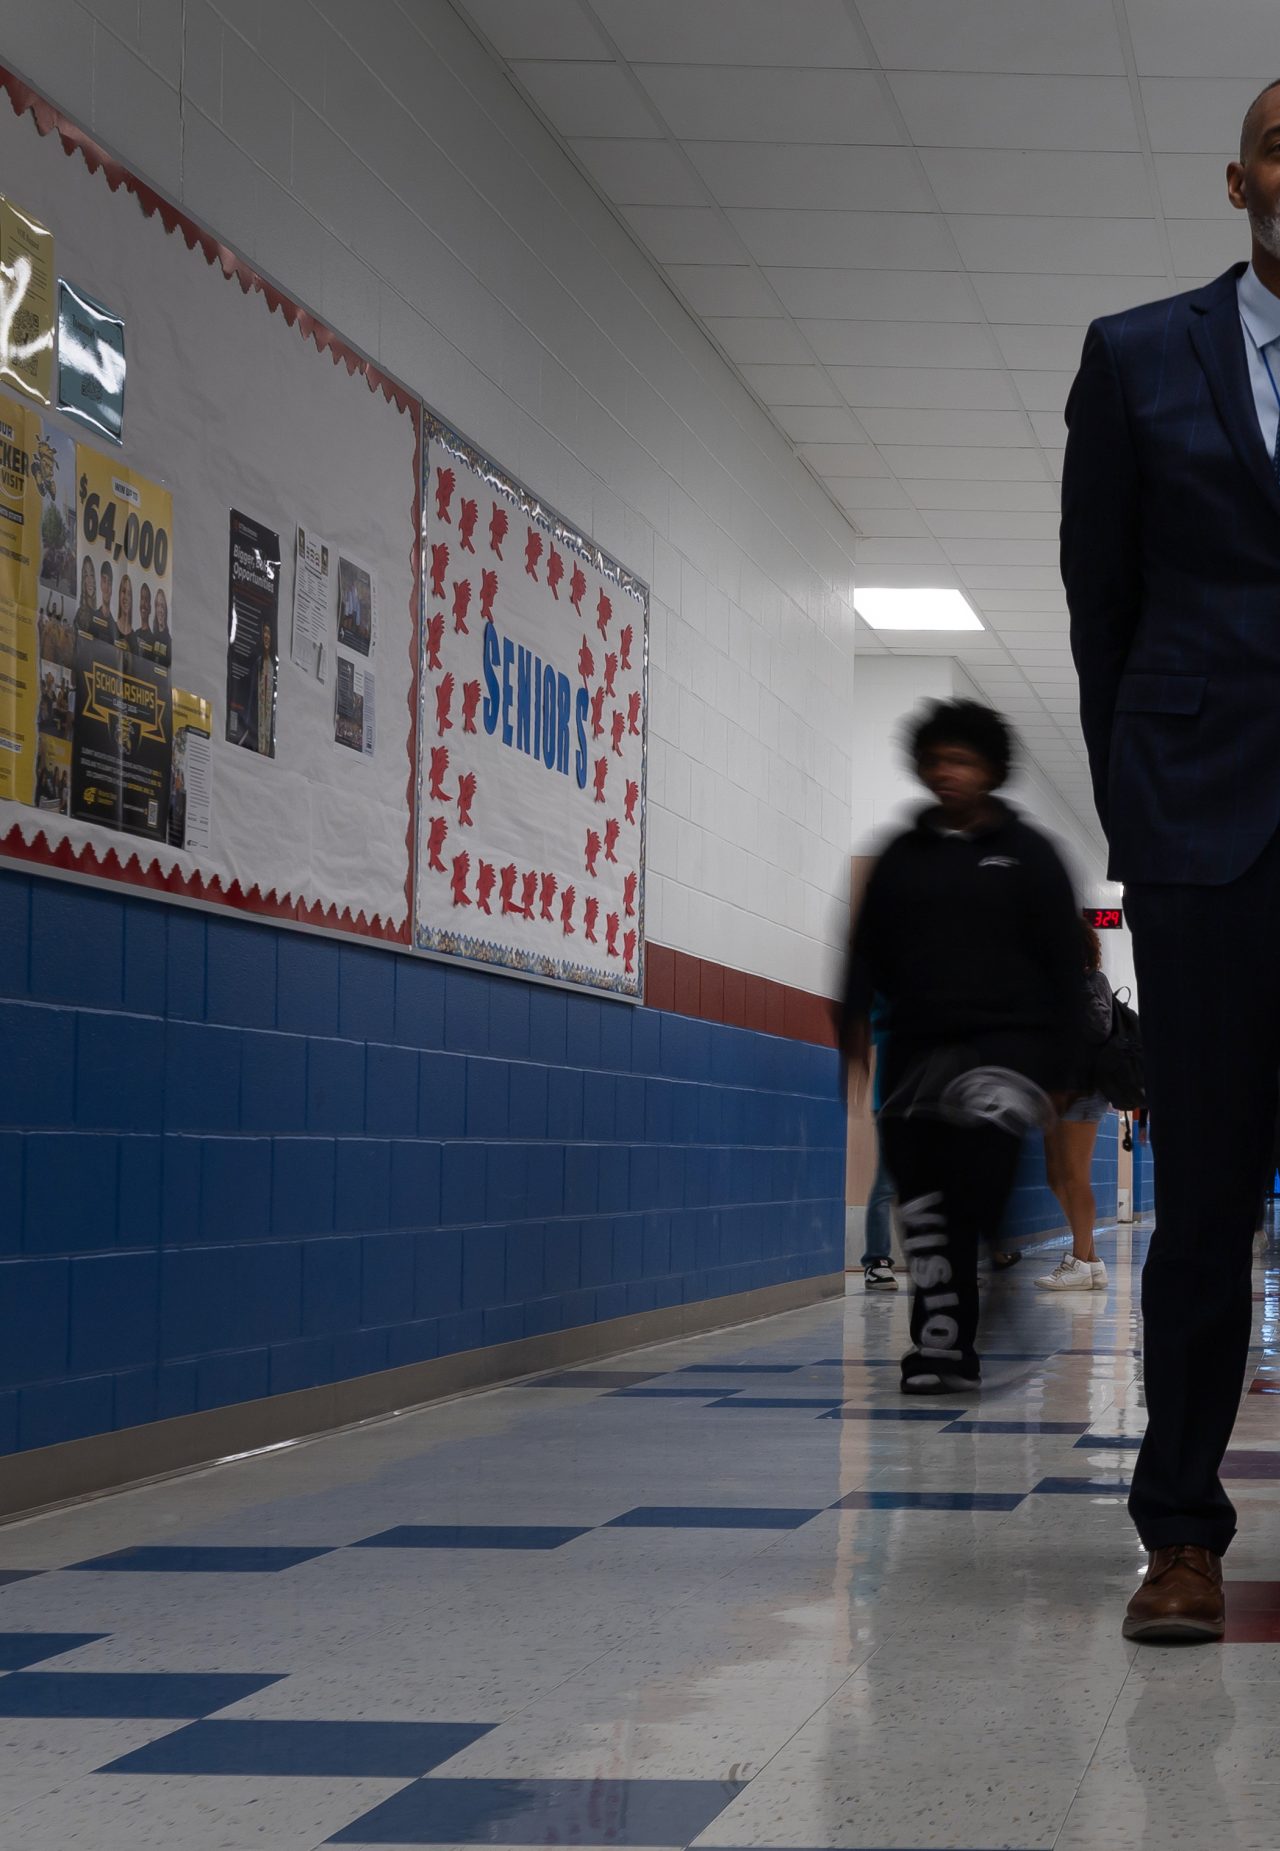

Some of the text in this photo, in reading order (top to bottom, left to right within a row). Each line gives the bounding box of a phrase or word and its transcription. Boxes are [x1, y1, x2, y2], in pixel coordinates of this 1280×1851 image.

[2, 472, 25, 492] VISIT
[80, 472, 168, 577] $64,000
[96, 671, 155, 709] SCHOLARSHIPS
[483, 622, 589, 789] SENIORS
